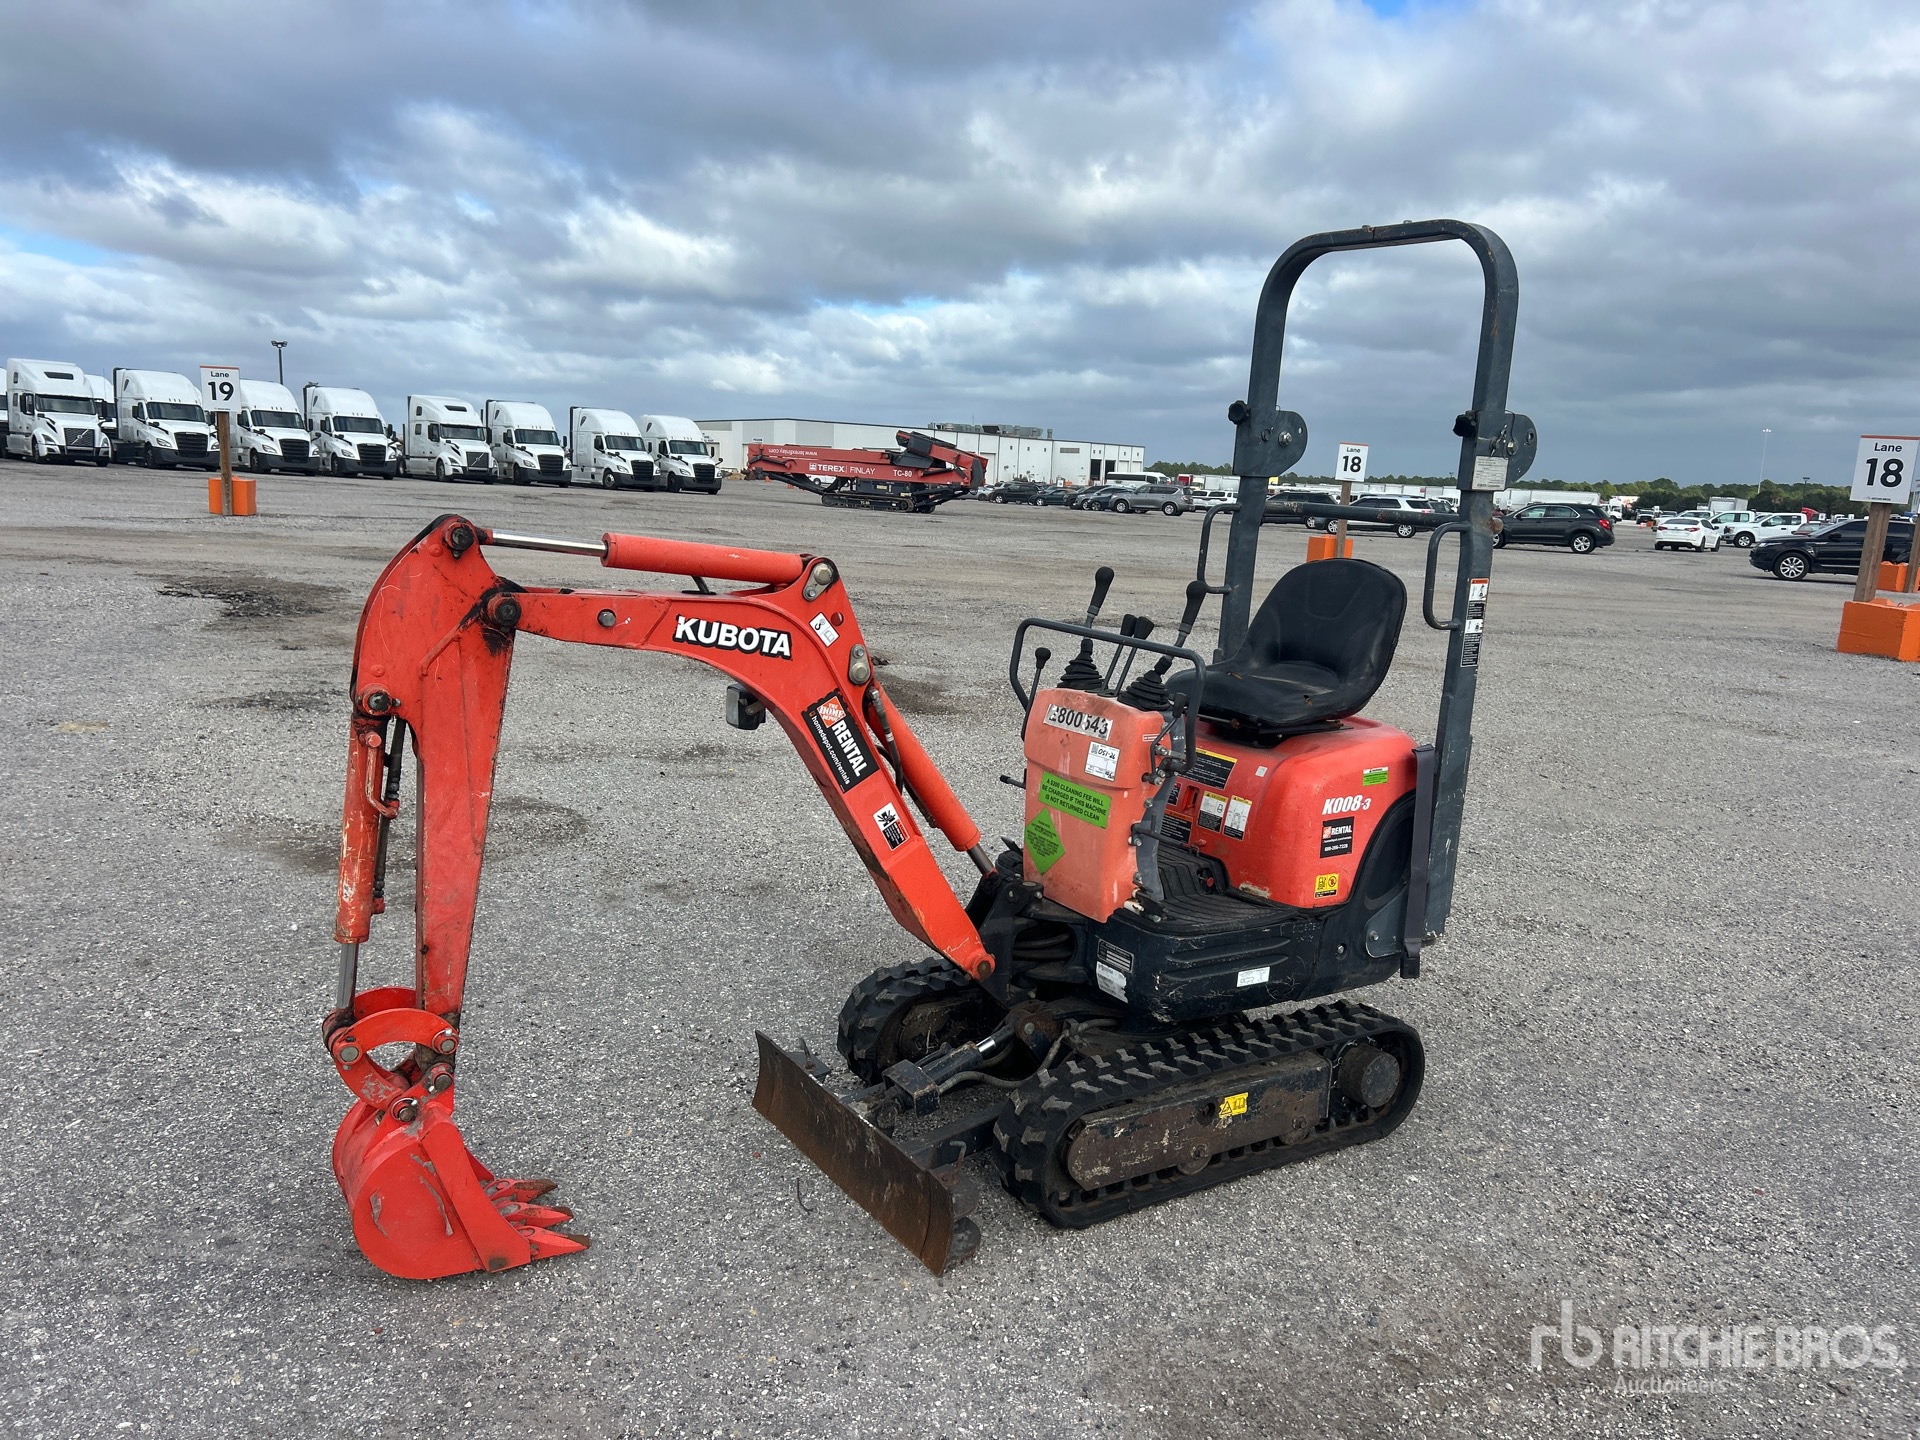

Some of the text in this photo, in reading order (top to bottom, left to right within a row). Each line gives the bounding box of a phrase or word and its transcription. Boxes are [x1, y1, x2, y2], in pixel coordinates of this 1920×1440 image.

[210, 370, 230, 378] Lane
[207, 381, 235, 401] 19
[1873, 442, 1903, 453] Lane
[817, 464, 876, 475] TEREX FINLAY
[893, 469, 913, 478] TC-80
[1342, 455, 1362, 473] 18
[1865, 457, 1904, 488] 18
[674, 615, 791, 657] KUBOTA
[819, 705, 844, 718] HOME
[811, 715, 851, 785] homedepot.com/rentals
[831, 719, 868, 777] RENTAL
[1048, 786, 1070, 800] CHARGED
[1074, 797, 1085, 807] THIS
[1085, 802, 1107, 816] MACHINE
[1060, 784, 1083, 798] CLEANING
[1083, 792, 1092, 801] FEE
[1092, 796, 1104, 807] WILL
[1321, 794, 1372, 816] K008-3
[1050, 795, 1059, 804] NOT
[1059, 799, 1083, 815] RETURNED
[1083, 810, 1100, 821] CLEAN
[1331, 825, 1353, 836] RENTAL
